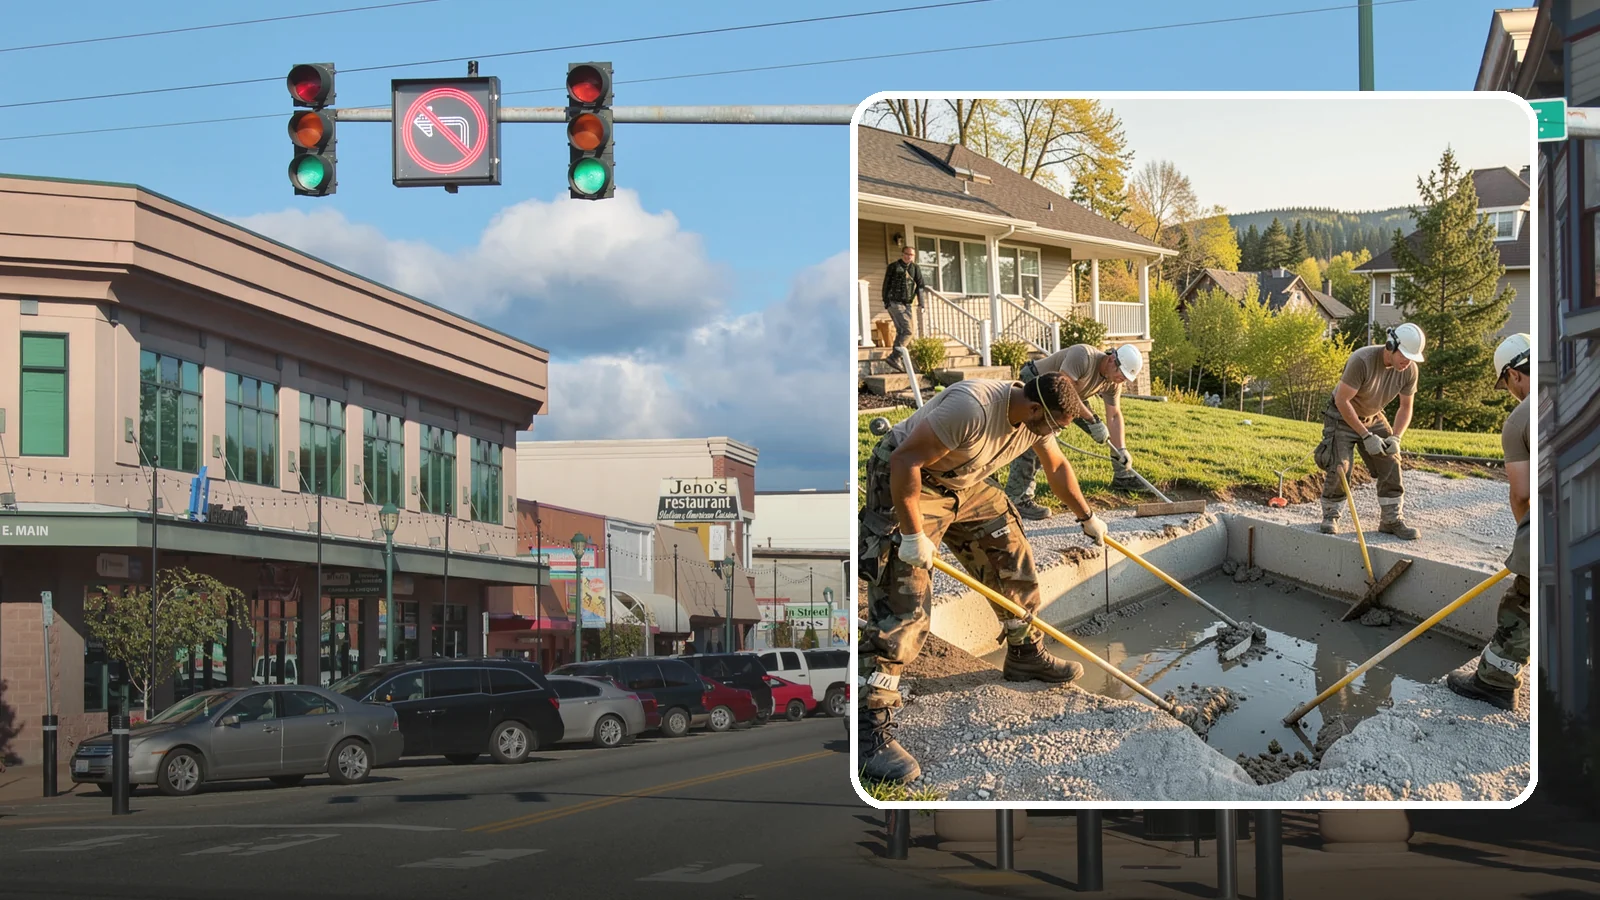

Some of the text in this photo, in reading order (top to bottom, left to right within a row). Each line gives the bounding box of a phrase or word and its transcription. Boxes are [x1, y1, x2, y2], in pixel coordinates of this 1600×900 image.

[669, 480, 728, 495] Jeno's
[665, 496, 731, 509] restaurant
[658, 509, 682, 519] Italian
[686, 509, 715, 519] American
[715, 509, 738, 519] Cuisine
[2, 525, 49, 536] E. MAIN
[797, 607, 829, 617] Street
